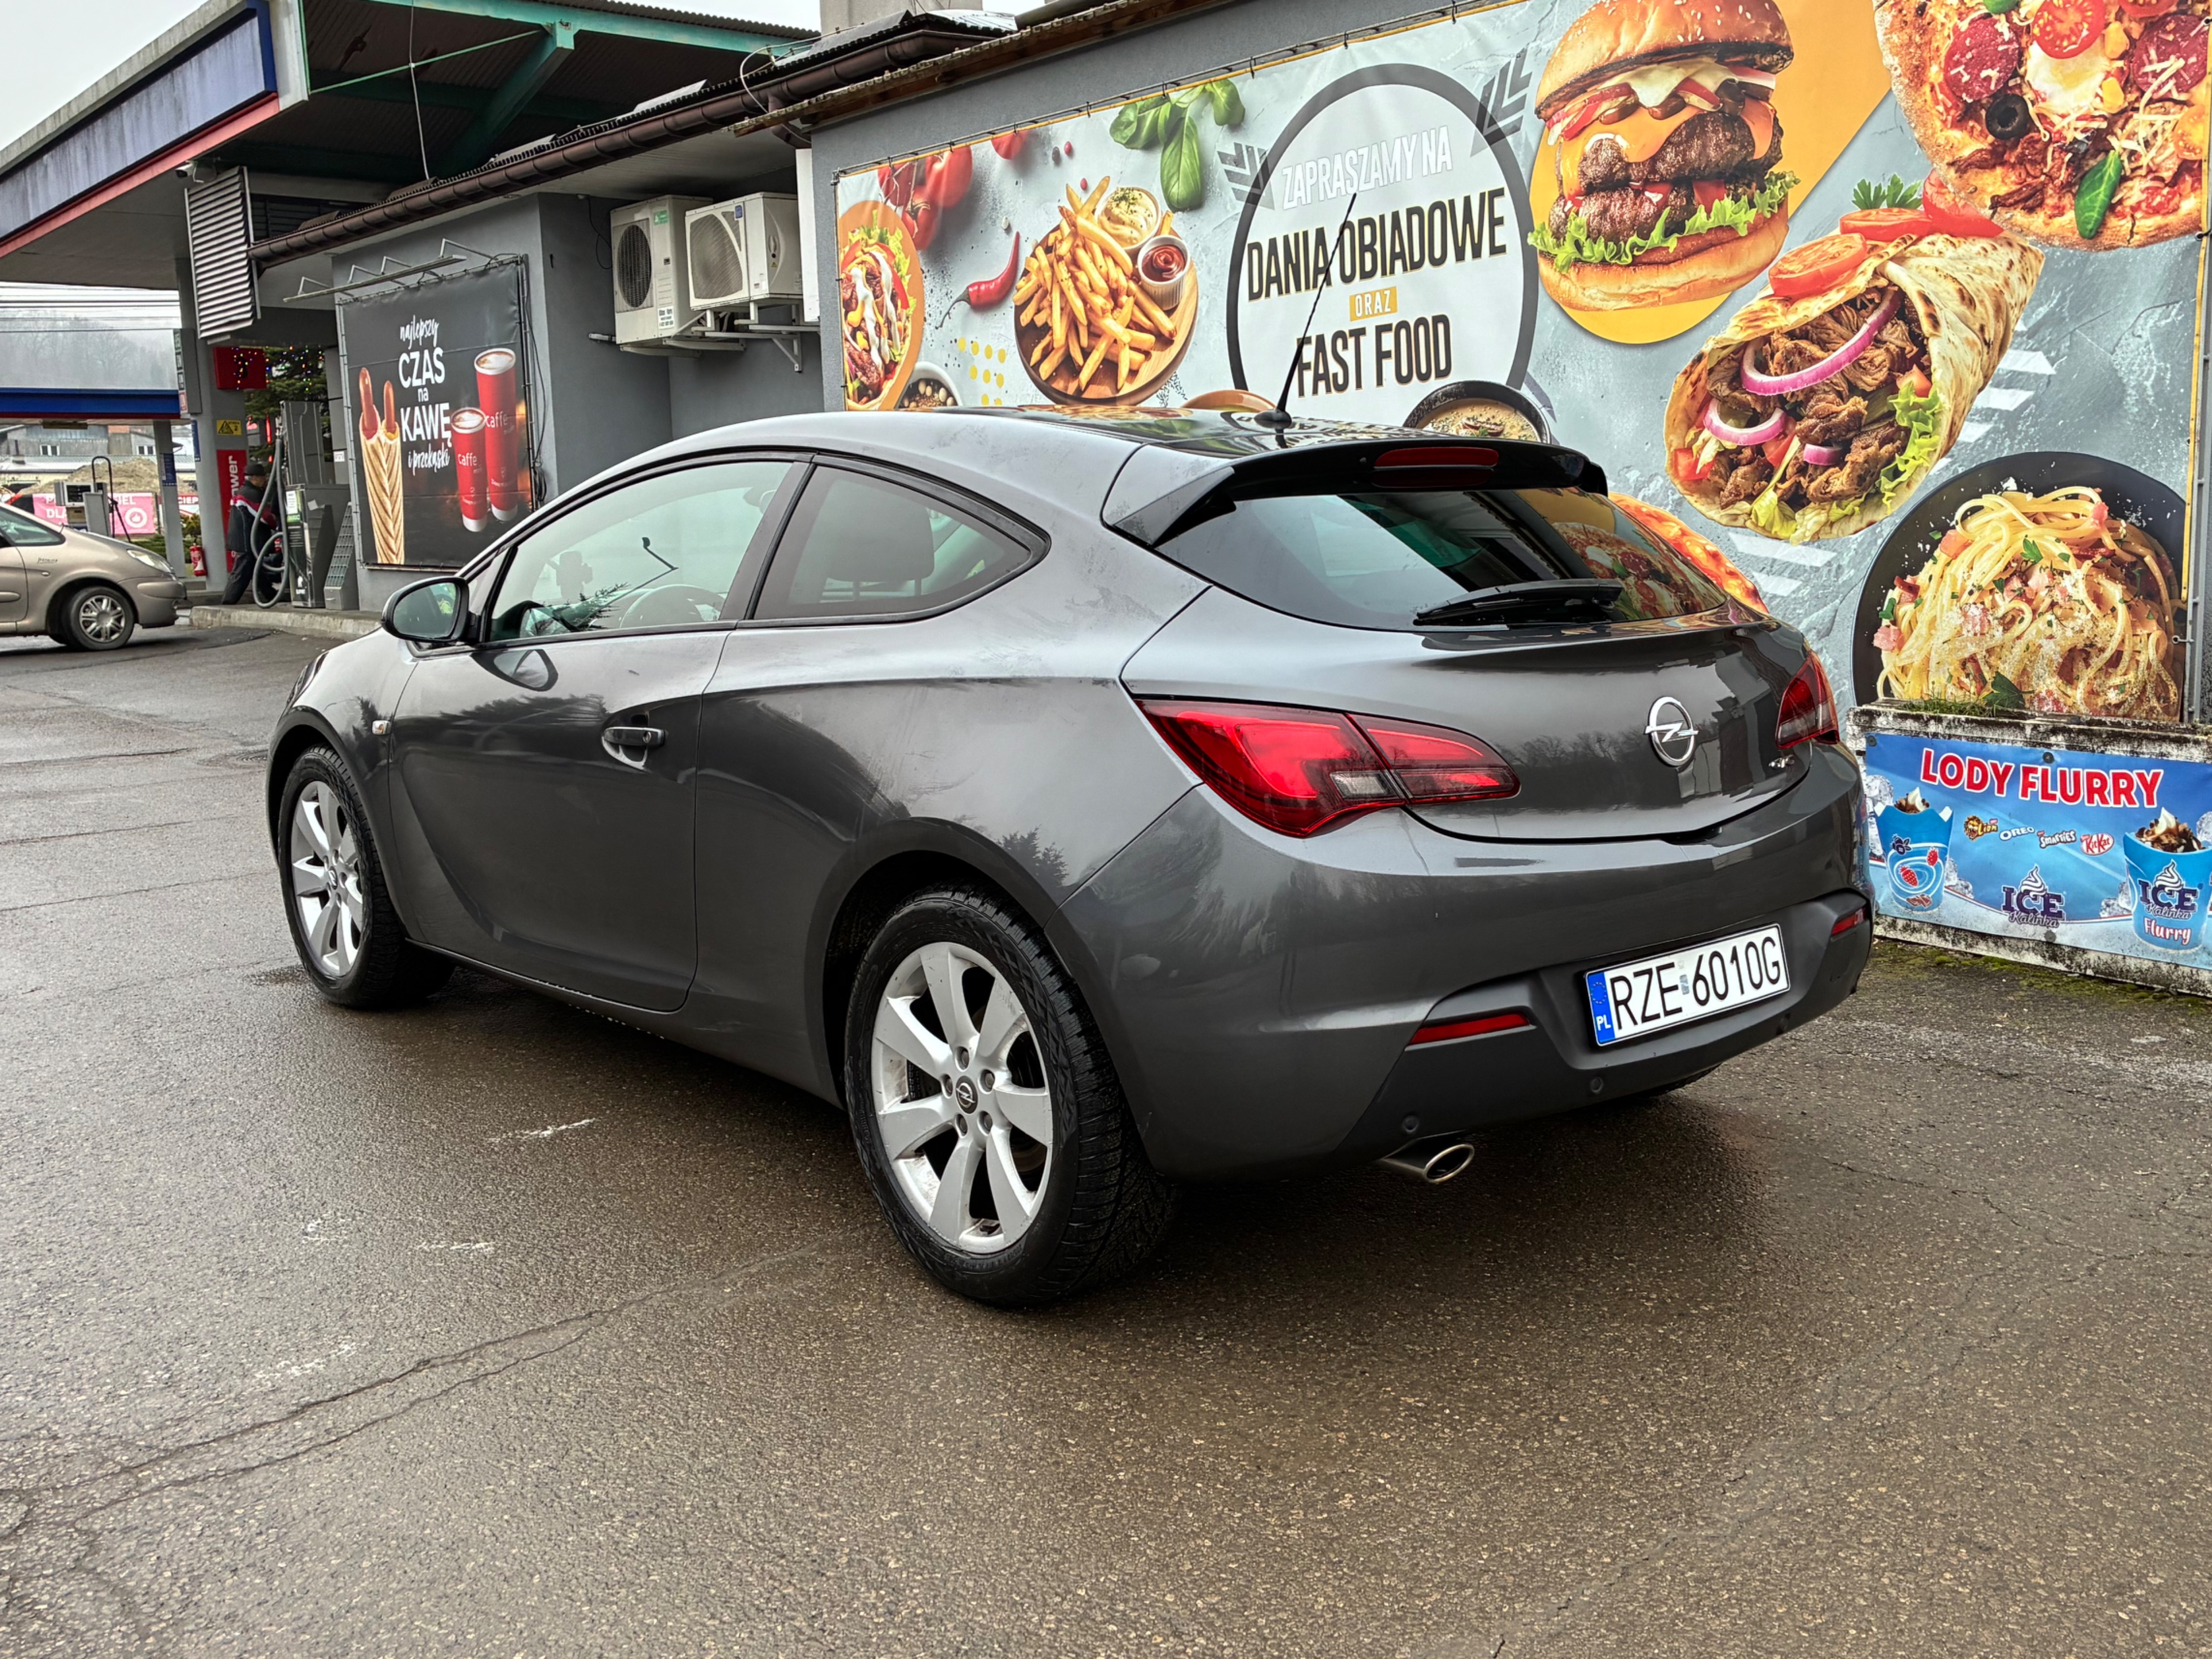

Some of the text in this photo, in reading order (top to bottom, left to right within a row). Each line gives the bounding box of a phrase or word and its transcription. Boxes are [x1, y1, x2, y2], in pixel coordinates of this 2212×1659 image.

[1281, 125, 1453, 210] ZAPRASZAMY NA
[1247, 186, 1507, 302] DANIA OBIADOWE
[1355, 290, 1391, 318] ORAZ
[400, 315, 440, 350] najlepszy
[398, 347, 445, 388] CZAS
[1296, 314, 1452, 398] FAST FOOD
[418, 387, 429, 402] na
[400, 402, 452, 448] KAWĘ
[485, 411, 507, 428] caffe
[408, 442, 450, 476] i przekąski
[458, 453, 477, 466] caffe
[1921, 748, 2164, 807] LODY FLURRY
[1999, 827, 2034, 841] OREO
[2001, 885, 2065, 921] ICE
[2137, 879, 2198, 913] ICE
[2146, 902, 2192, 919] Kalinka
[2009, 910, 2060, 928] Kalinka
[2144, 917, 2191, 945] Flurry
[1609, 936, 1781, 1031] RZE 6010G
[1596, 1015, 1611, 1031] PL
